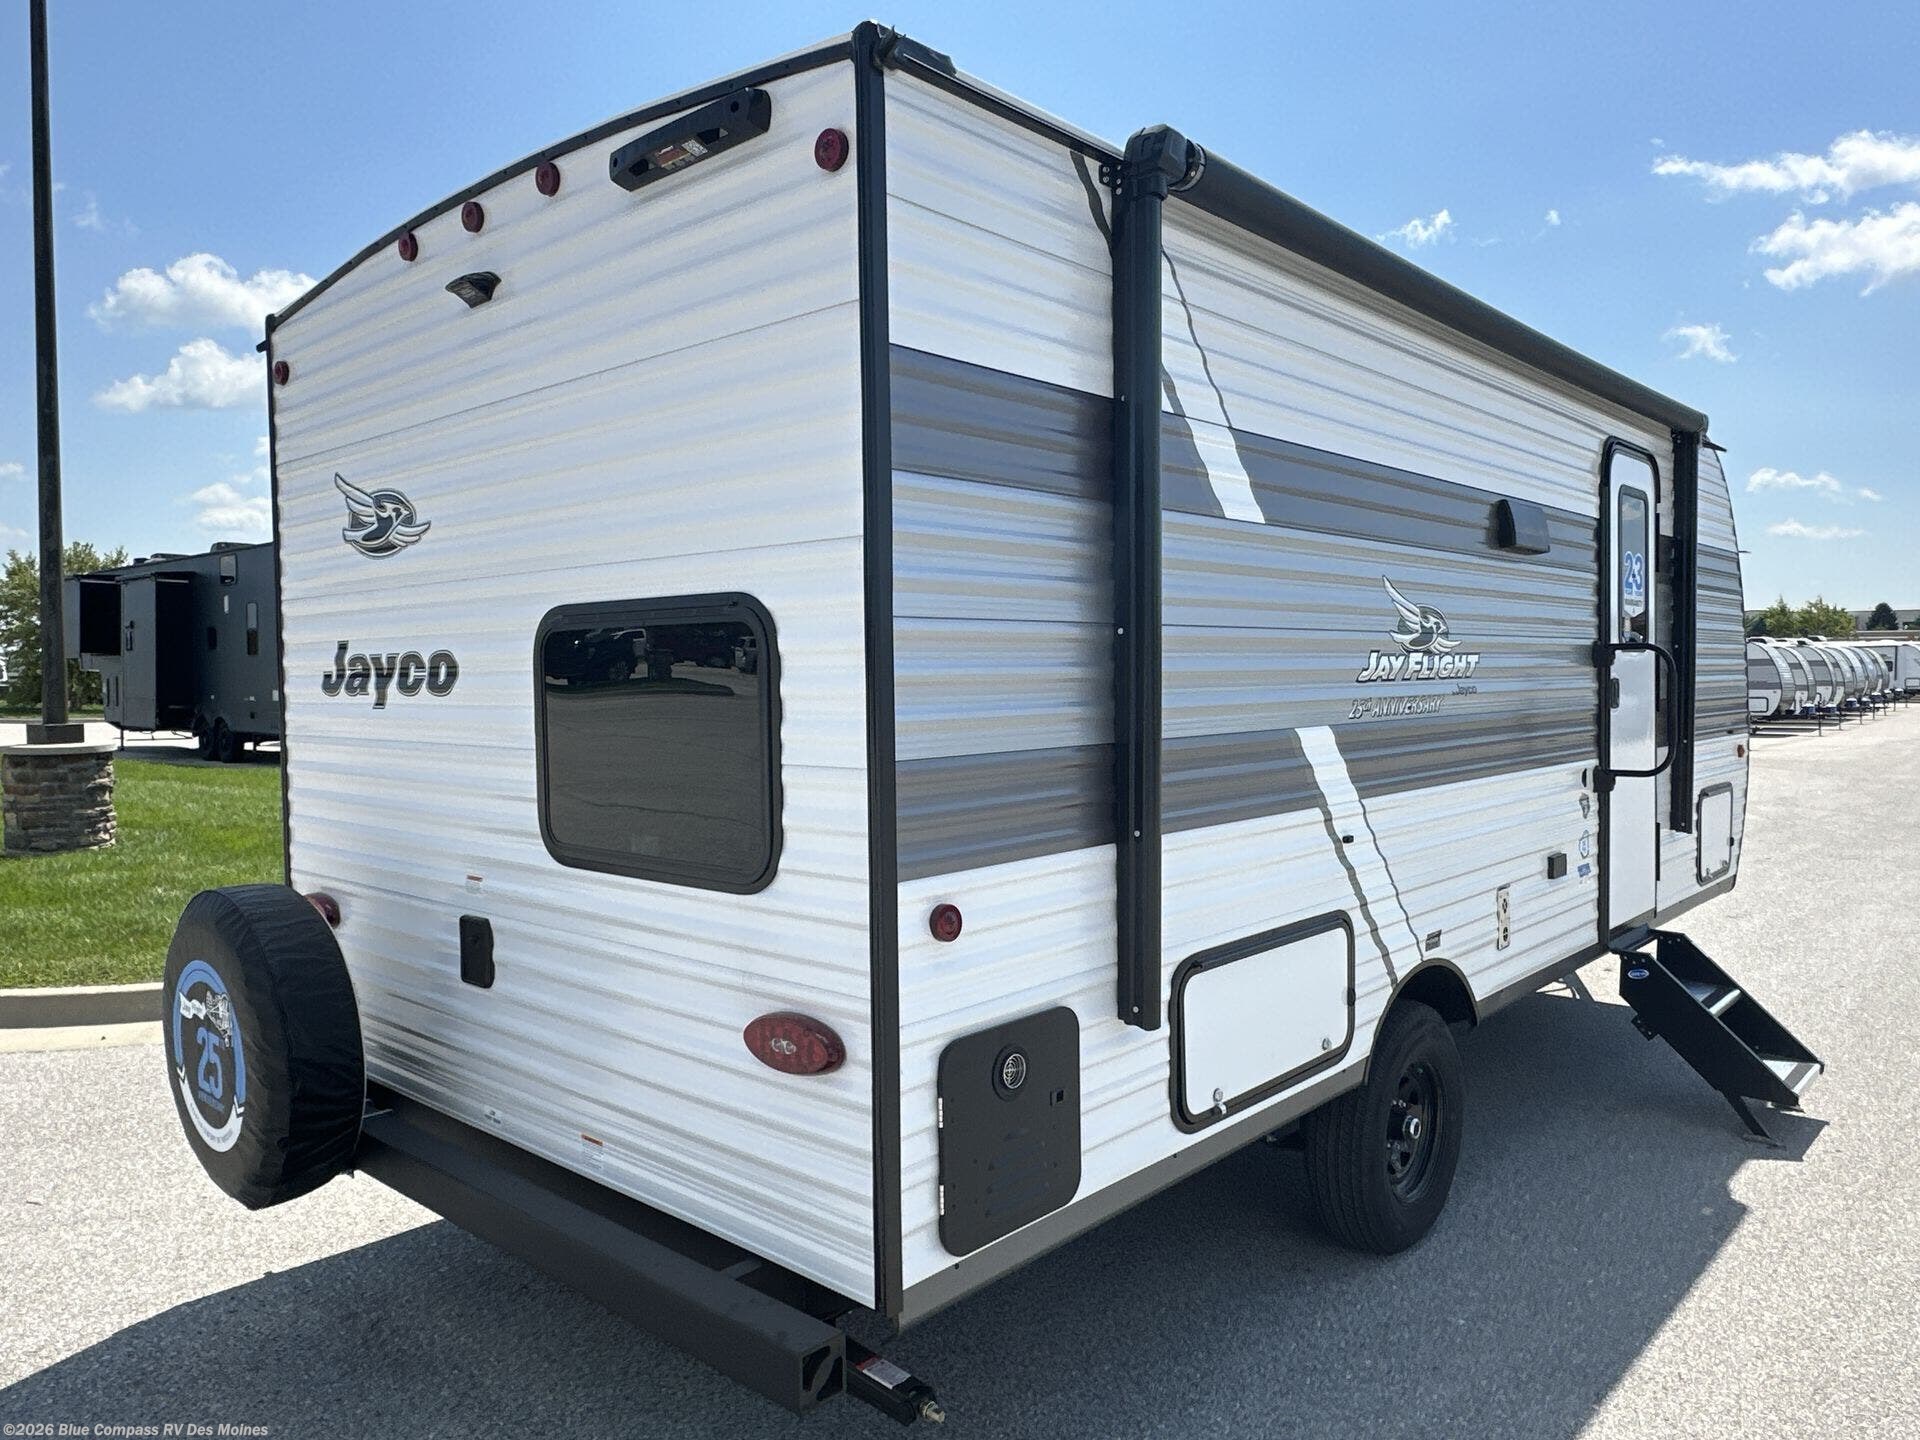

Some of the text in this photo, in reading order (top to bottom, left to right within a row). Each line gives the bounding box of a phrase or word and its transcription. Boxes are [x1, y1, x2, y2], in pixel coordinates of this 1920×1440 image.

[321, 640, 460, 710] Jayco
[1356, 650, 1481, 683] JAY FLIGHT
[1371, 695, 1445, 718] ANNIVERSARY
[197, 1026, 223, 1101] 25
